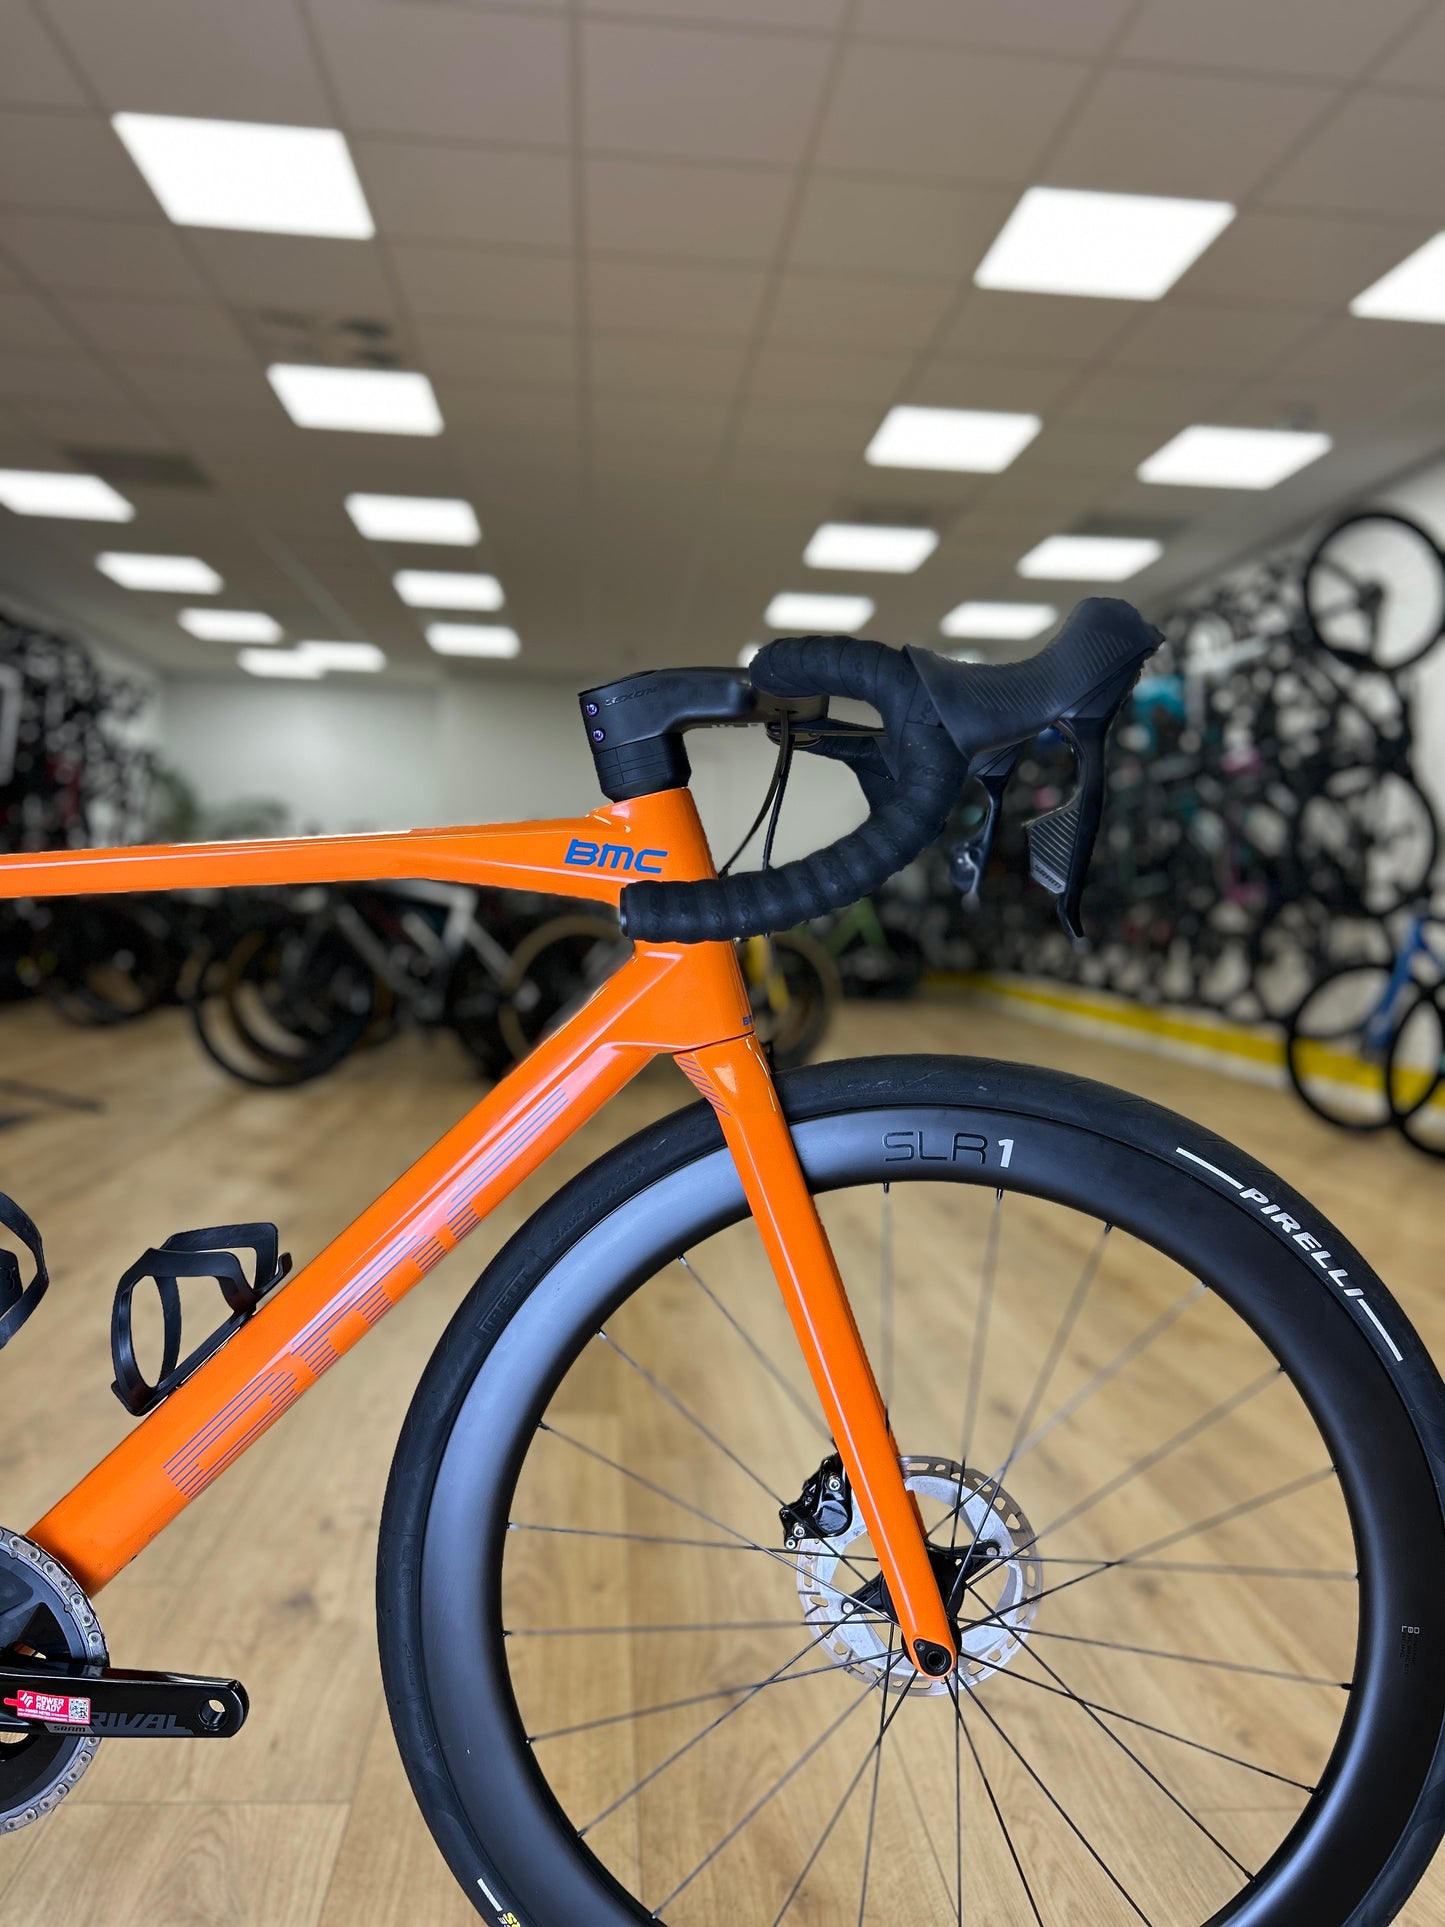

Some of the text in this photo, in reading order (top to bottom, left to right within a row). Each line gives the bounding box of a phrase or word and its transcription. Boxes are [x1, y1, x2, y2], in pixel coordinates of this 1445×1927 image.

[564, 838, 669, 874] BMC
[882, 1131, 1015, 1169] SLR 1
[1239, 1187, 1364, 1300] PIRELLI
[35, 1695, 64, 1707] POWER
[36, 1703, 62, 1713] READY
[53, 1725, 86, 1733] SRAM
[92, 1712, 186, 1730] RIVAL
